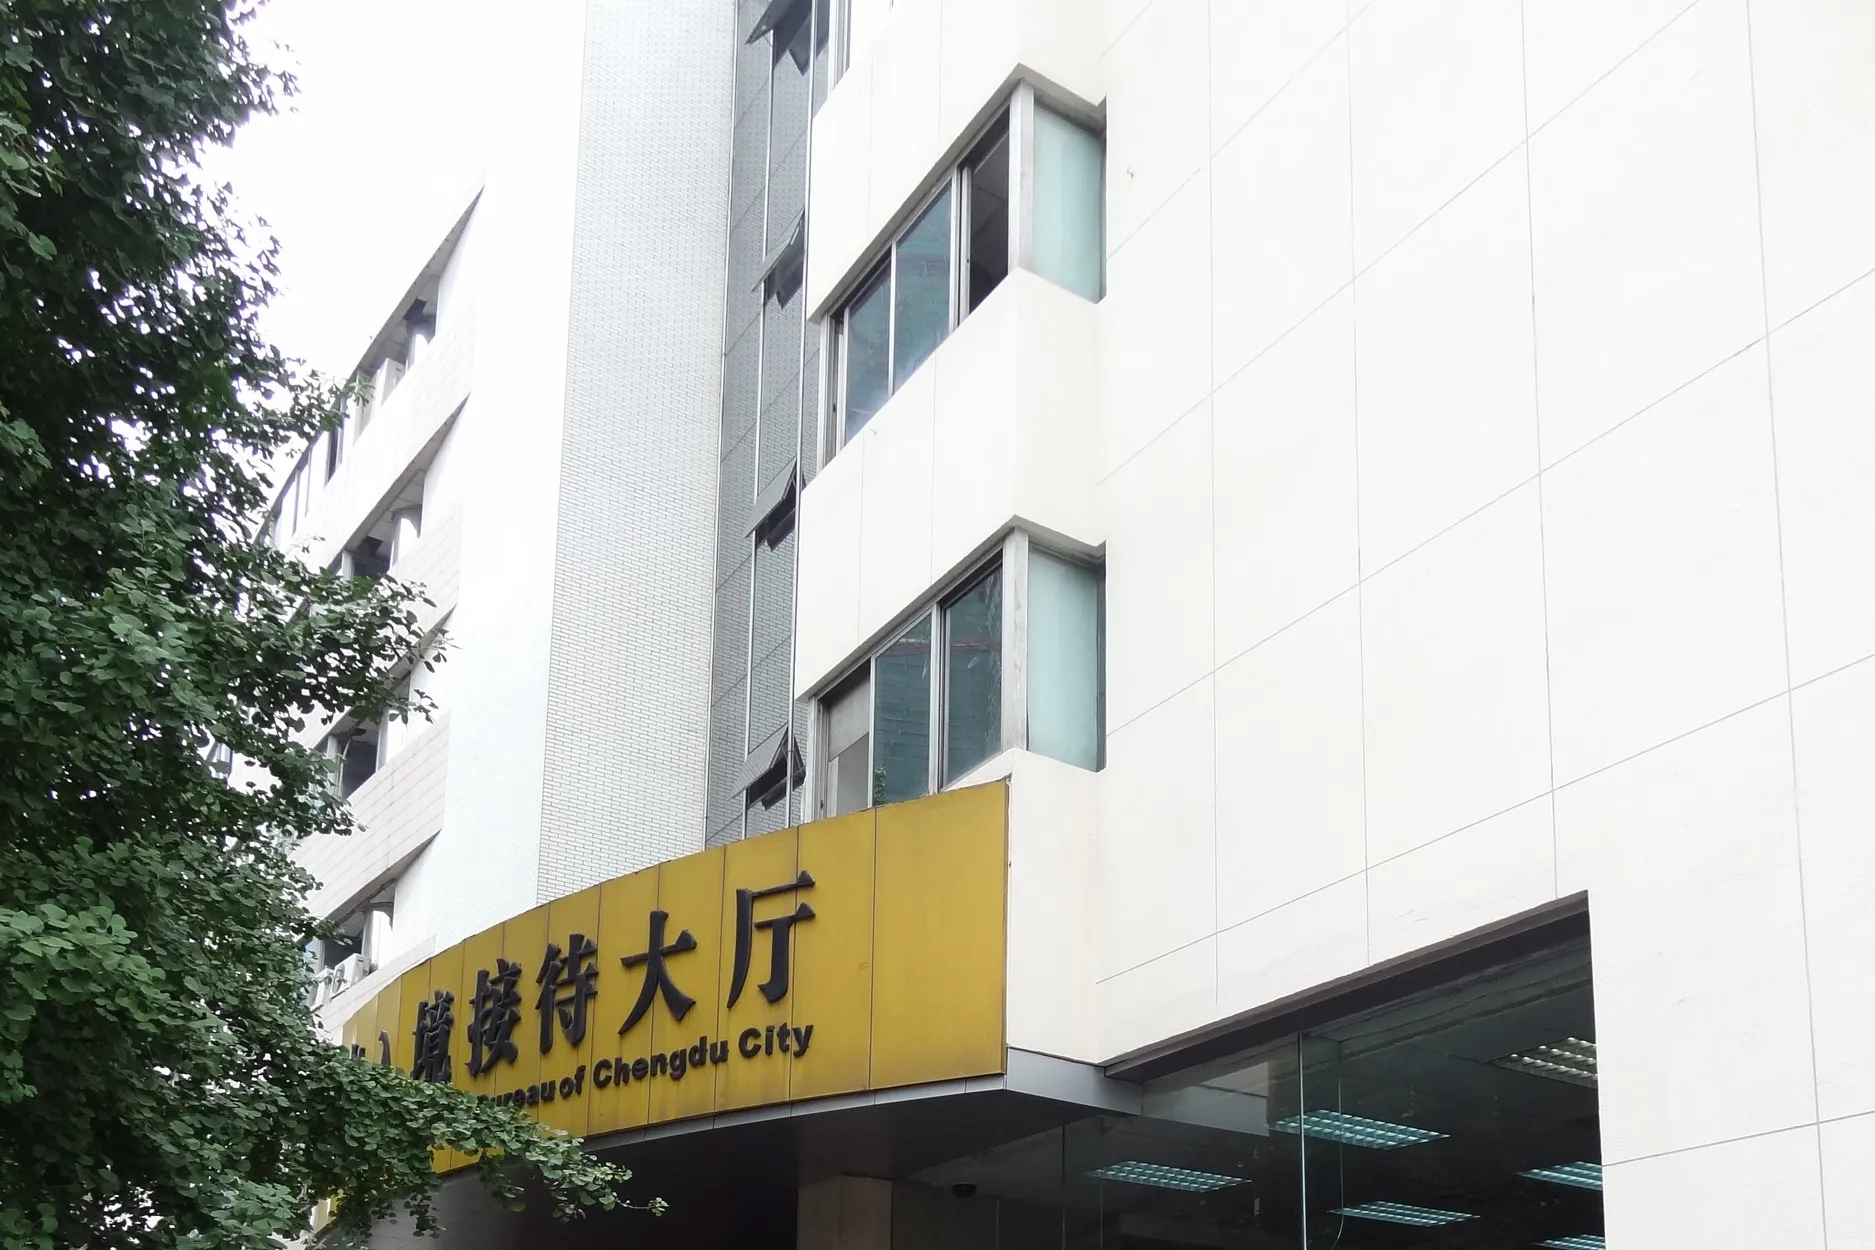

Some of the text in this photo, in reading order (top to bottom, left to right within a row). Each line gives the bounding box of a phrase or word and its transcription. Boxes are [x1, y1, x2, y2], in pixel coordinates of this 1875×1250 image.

[351, 870, 816, 1083] 境接待大厅
[558, 1065, 586, 1098] of
[593, 1036, 729, 1089] Chengdu
[738, 1022, 814, 1058] City
